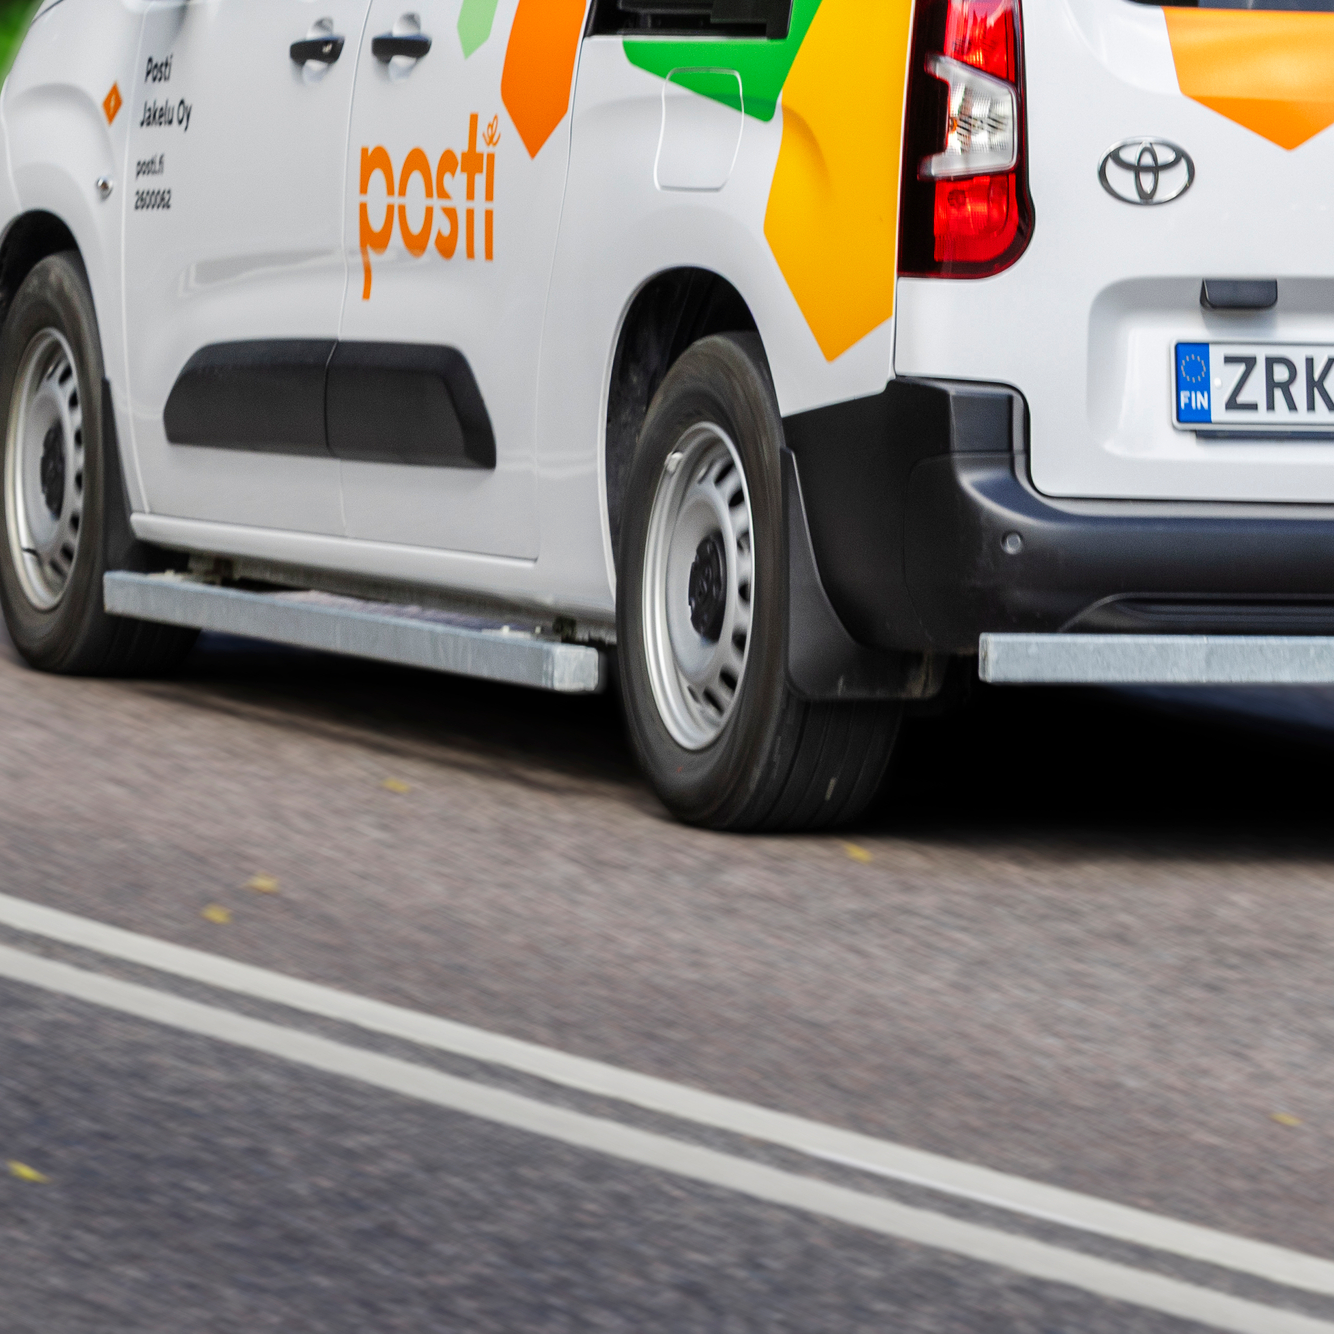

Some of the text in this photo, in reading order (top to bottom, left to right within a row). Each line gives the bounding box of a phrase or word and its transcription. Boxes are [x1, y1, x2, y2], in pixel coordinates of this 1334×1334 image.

[145, 54, 173, 83] Posti
[140, 98, 192, 133] Jakelu Oy
[136, 153, 165, 180] posti.fi
[359, 112, 500, 301] posti
[1180, 390, 1209, 410] FIN
